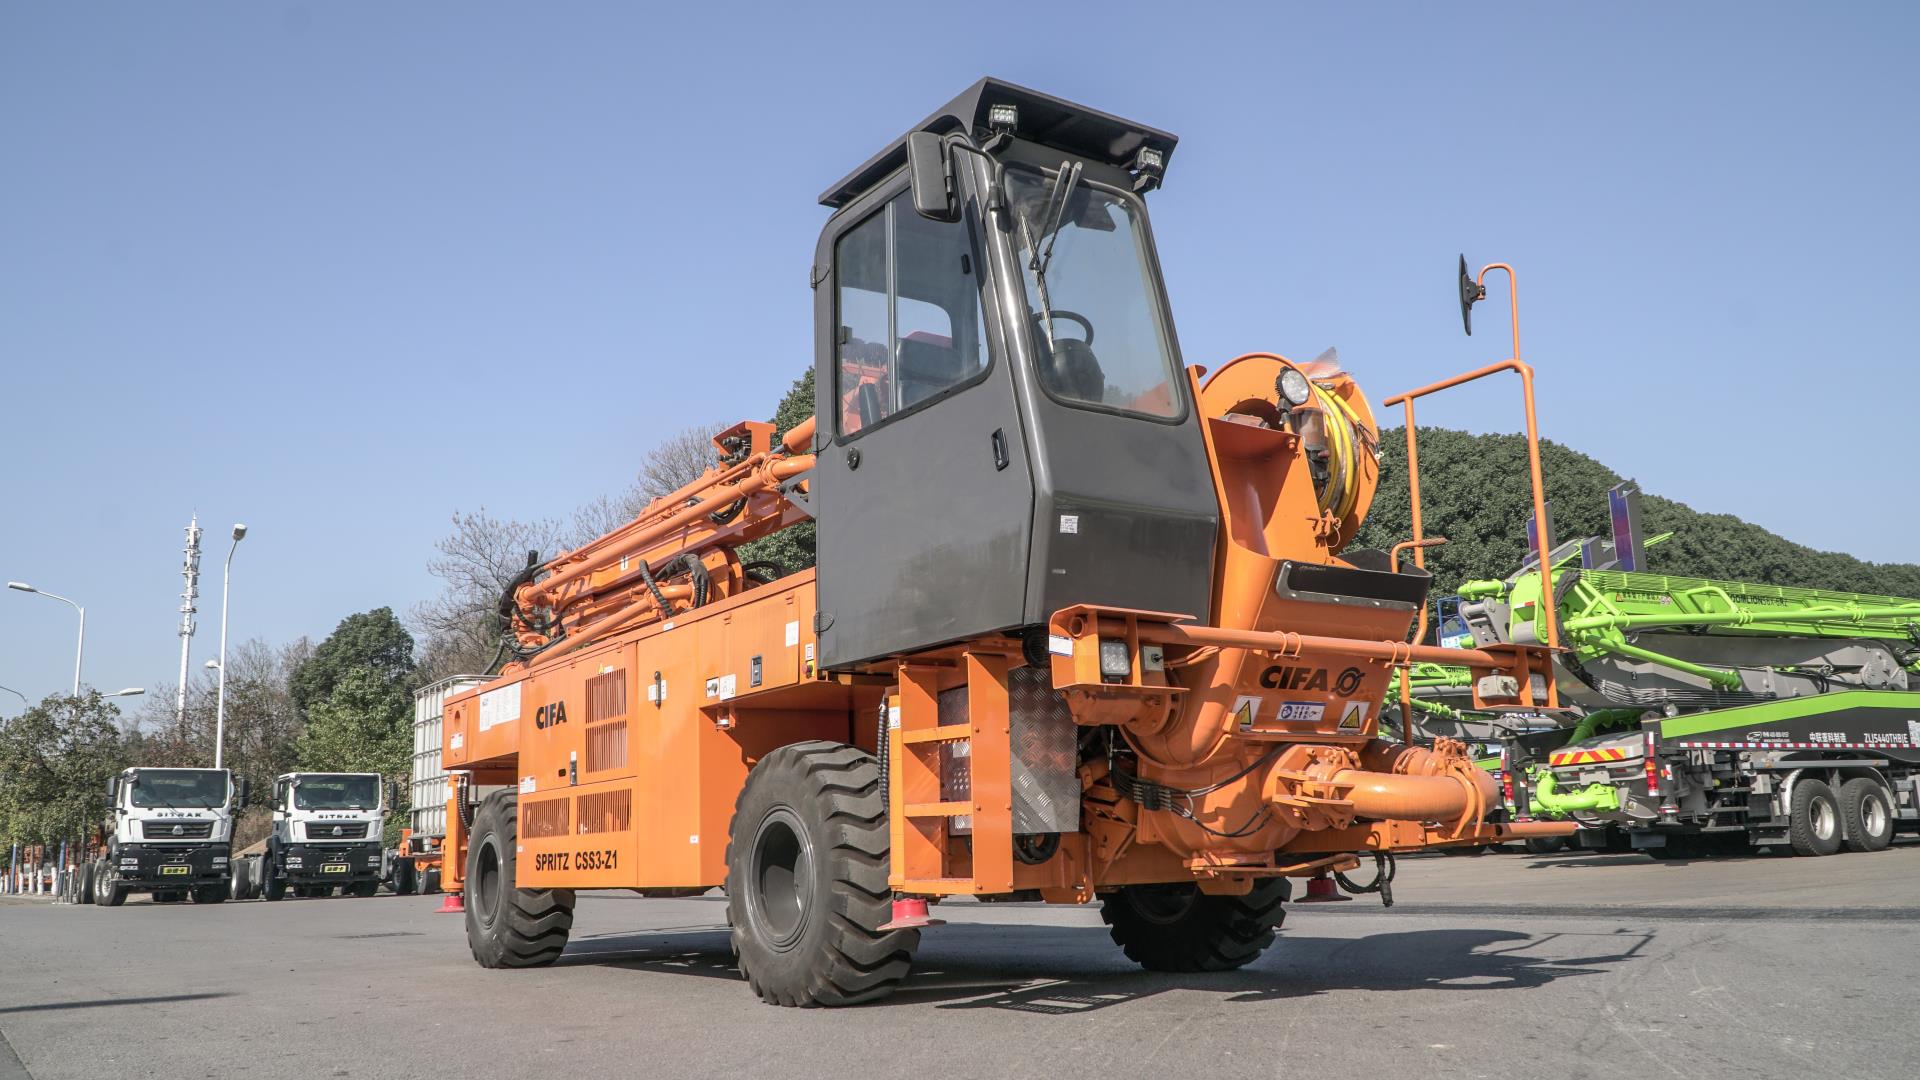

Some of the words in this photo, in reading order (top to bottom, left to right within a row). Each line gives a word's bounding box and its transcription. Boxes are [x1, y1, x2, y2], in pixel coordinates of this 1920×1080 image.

[1259, 665, 1329, 692] CIFA
[535, 700, 568, 730] CIFA
[535, 852, 570, 871] SPRITZ
[575, 849, 618, 871] CSS3-Z1
